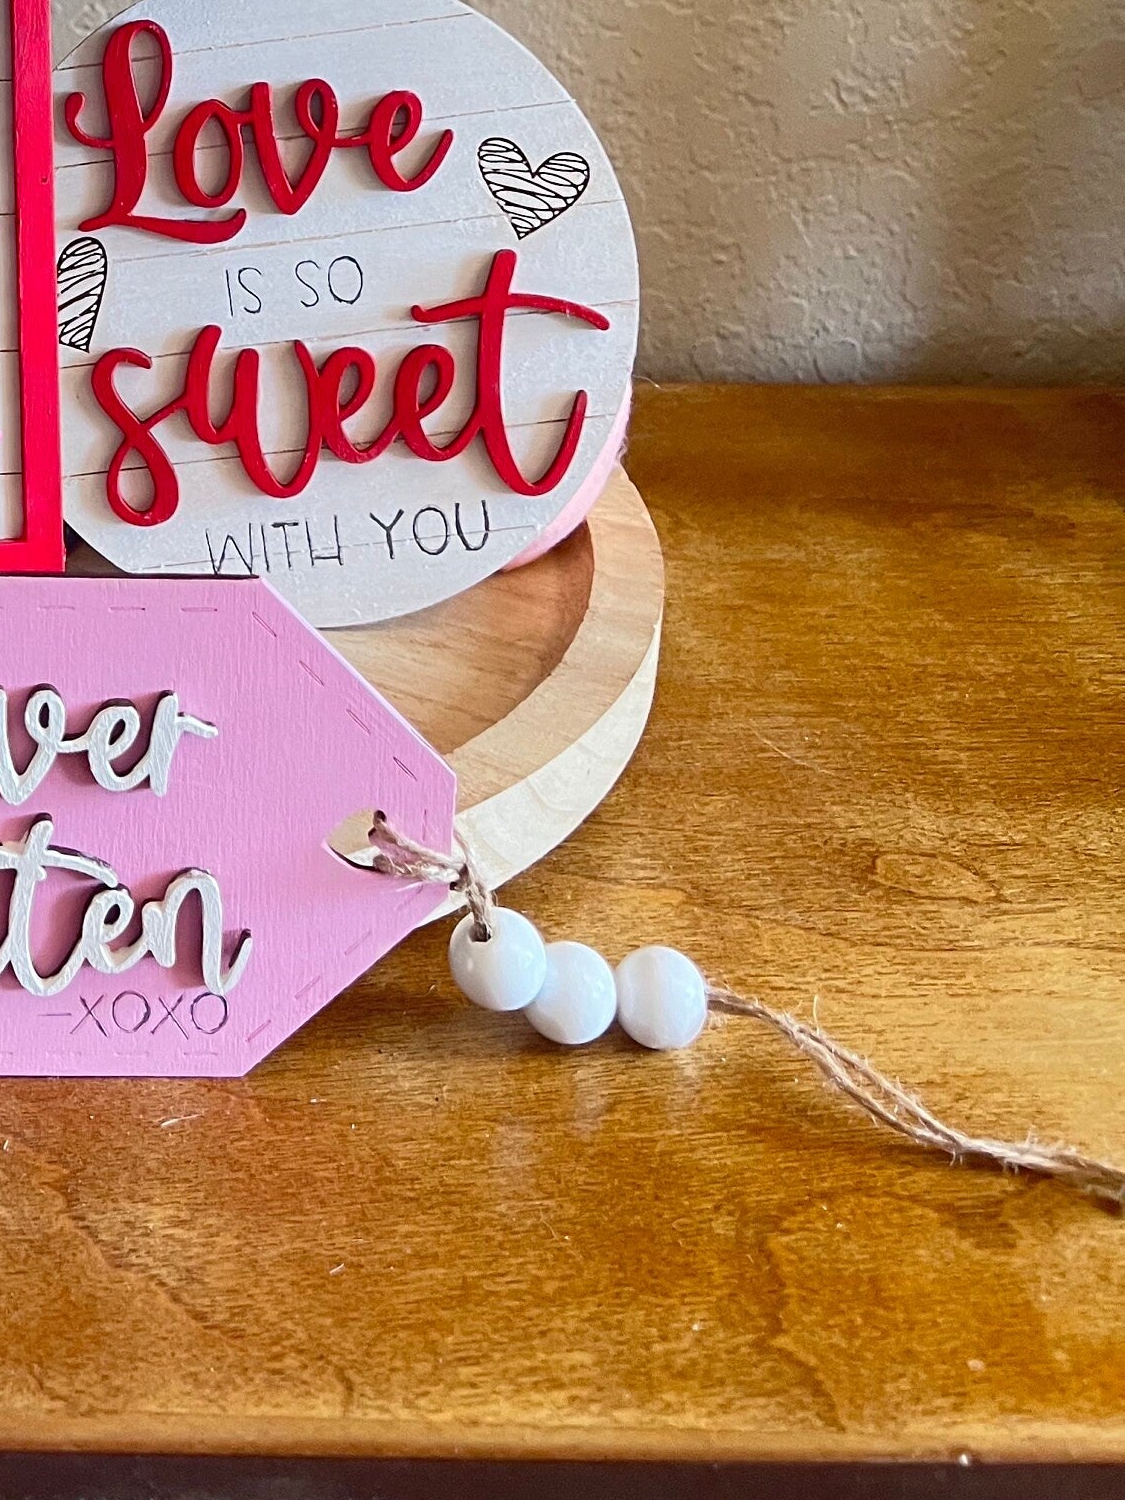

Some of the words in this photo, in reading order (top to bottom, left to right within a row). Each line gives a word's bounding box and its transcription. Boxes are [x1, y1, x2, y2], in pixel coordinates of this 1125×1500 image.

[65, 19, 454, 244] Love
[226, 265, 263, 317] IS
[299, 255, 364, 309] SO
[91, 248, 611, 527] sweet
[205, 514, 344, 576] WITH
[369, 499, 491, 560] YOU
